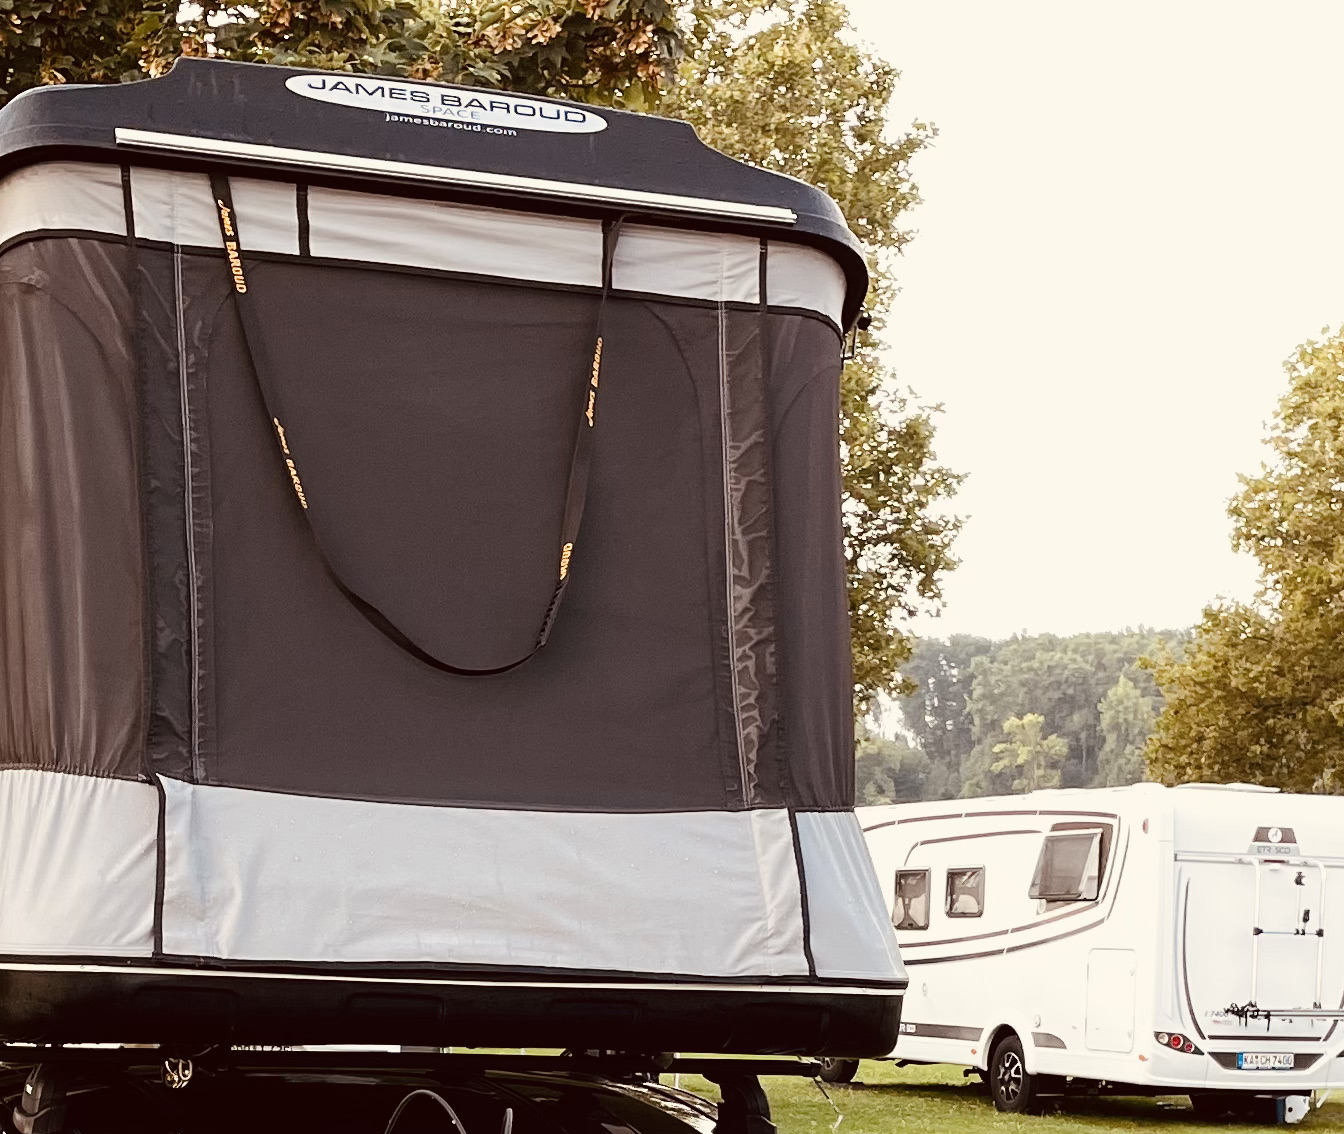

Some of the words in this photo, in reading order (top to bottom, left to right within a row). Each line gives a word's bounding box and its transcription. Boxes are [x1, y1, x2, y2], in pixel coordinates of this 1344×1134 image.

[307, 78, 431, 104] JAMES
[439, 93, 588, 125] BAROUD
[420, 104, 481, 120] SPACE
[385, 113, 517, 136] jamesbaroud.com
[225, 241, 248, 294] BAROUD
[1256, 845, 1292, 855] ETRSCO
